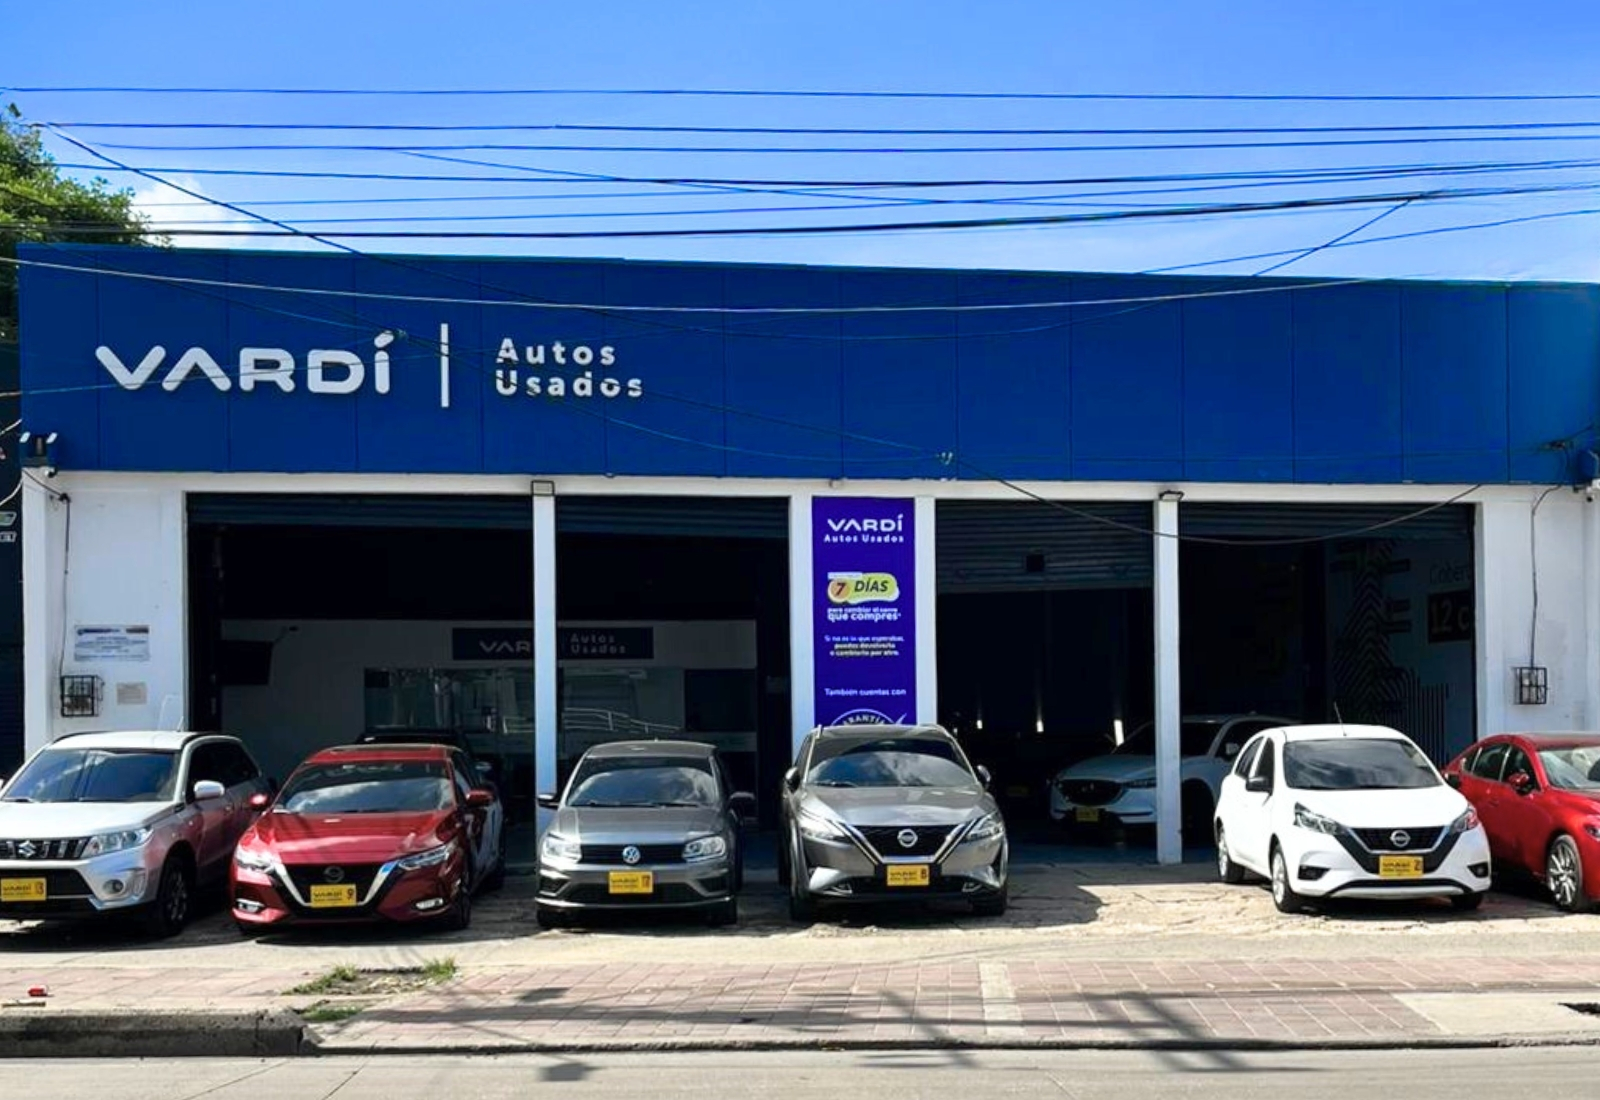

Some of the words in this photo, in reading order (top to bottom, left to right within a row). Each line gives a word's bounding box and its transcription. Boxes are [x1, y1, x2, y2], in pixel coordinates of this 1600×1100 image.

[495, 337, 617, 365] Autos
[95, 329, 395, 394] VARDÍ
[495, 370, 643, 397] Usados
[827, 513, 904, 532] VARDÍ
[823, 534, 858, 543] Autos
[862, 534, 904, 543] Usados
[835, 582, 847, 597] 7
[854, 577, 889, 592] DÍAS
[827, 612, 849, 623] que
[570, 633, 615, 644] Autos
[570, 643, 626, 654] Usados
